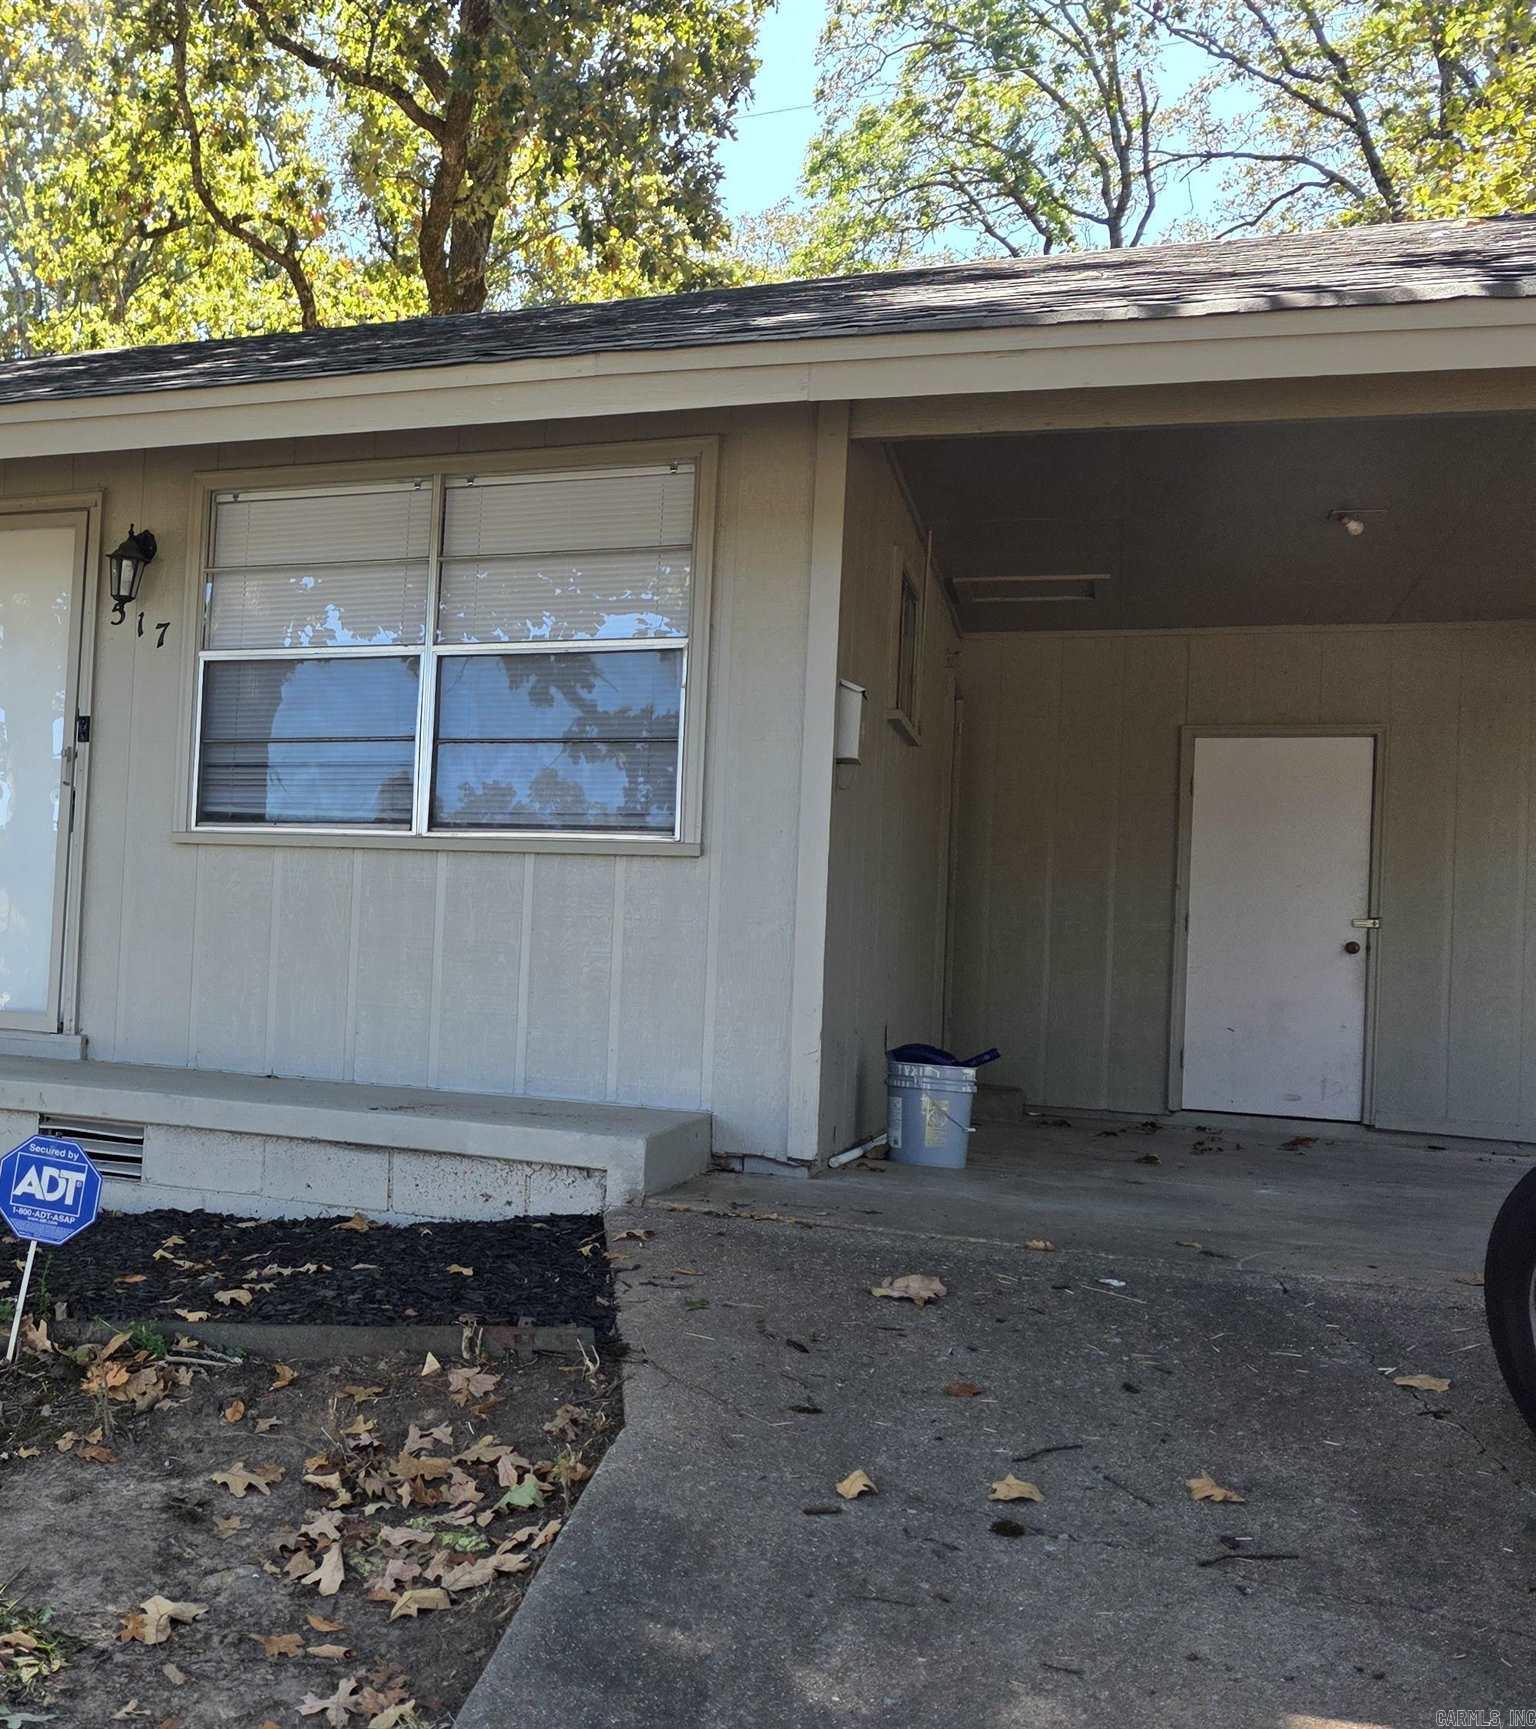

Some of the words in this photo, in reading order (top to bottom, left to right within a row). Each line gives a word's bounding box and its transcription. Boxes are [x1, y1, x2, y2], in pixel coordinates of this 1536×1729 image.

[29, 1143, 65, 1157] Secured
[68, 1151, 80, 1161] by
[13, 1164, 86, 1205] ADT
